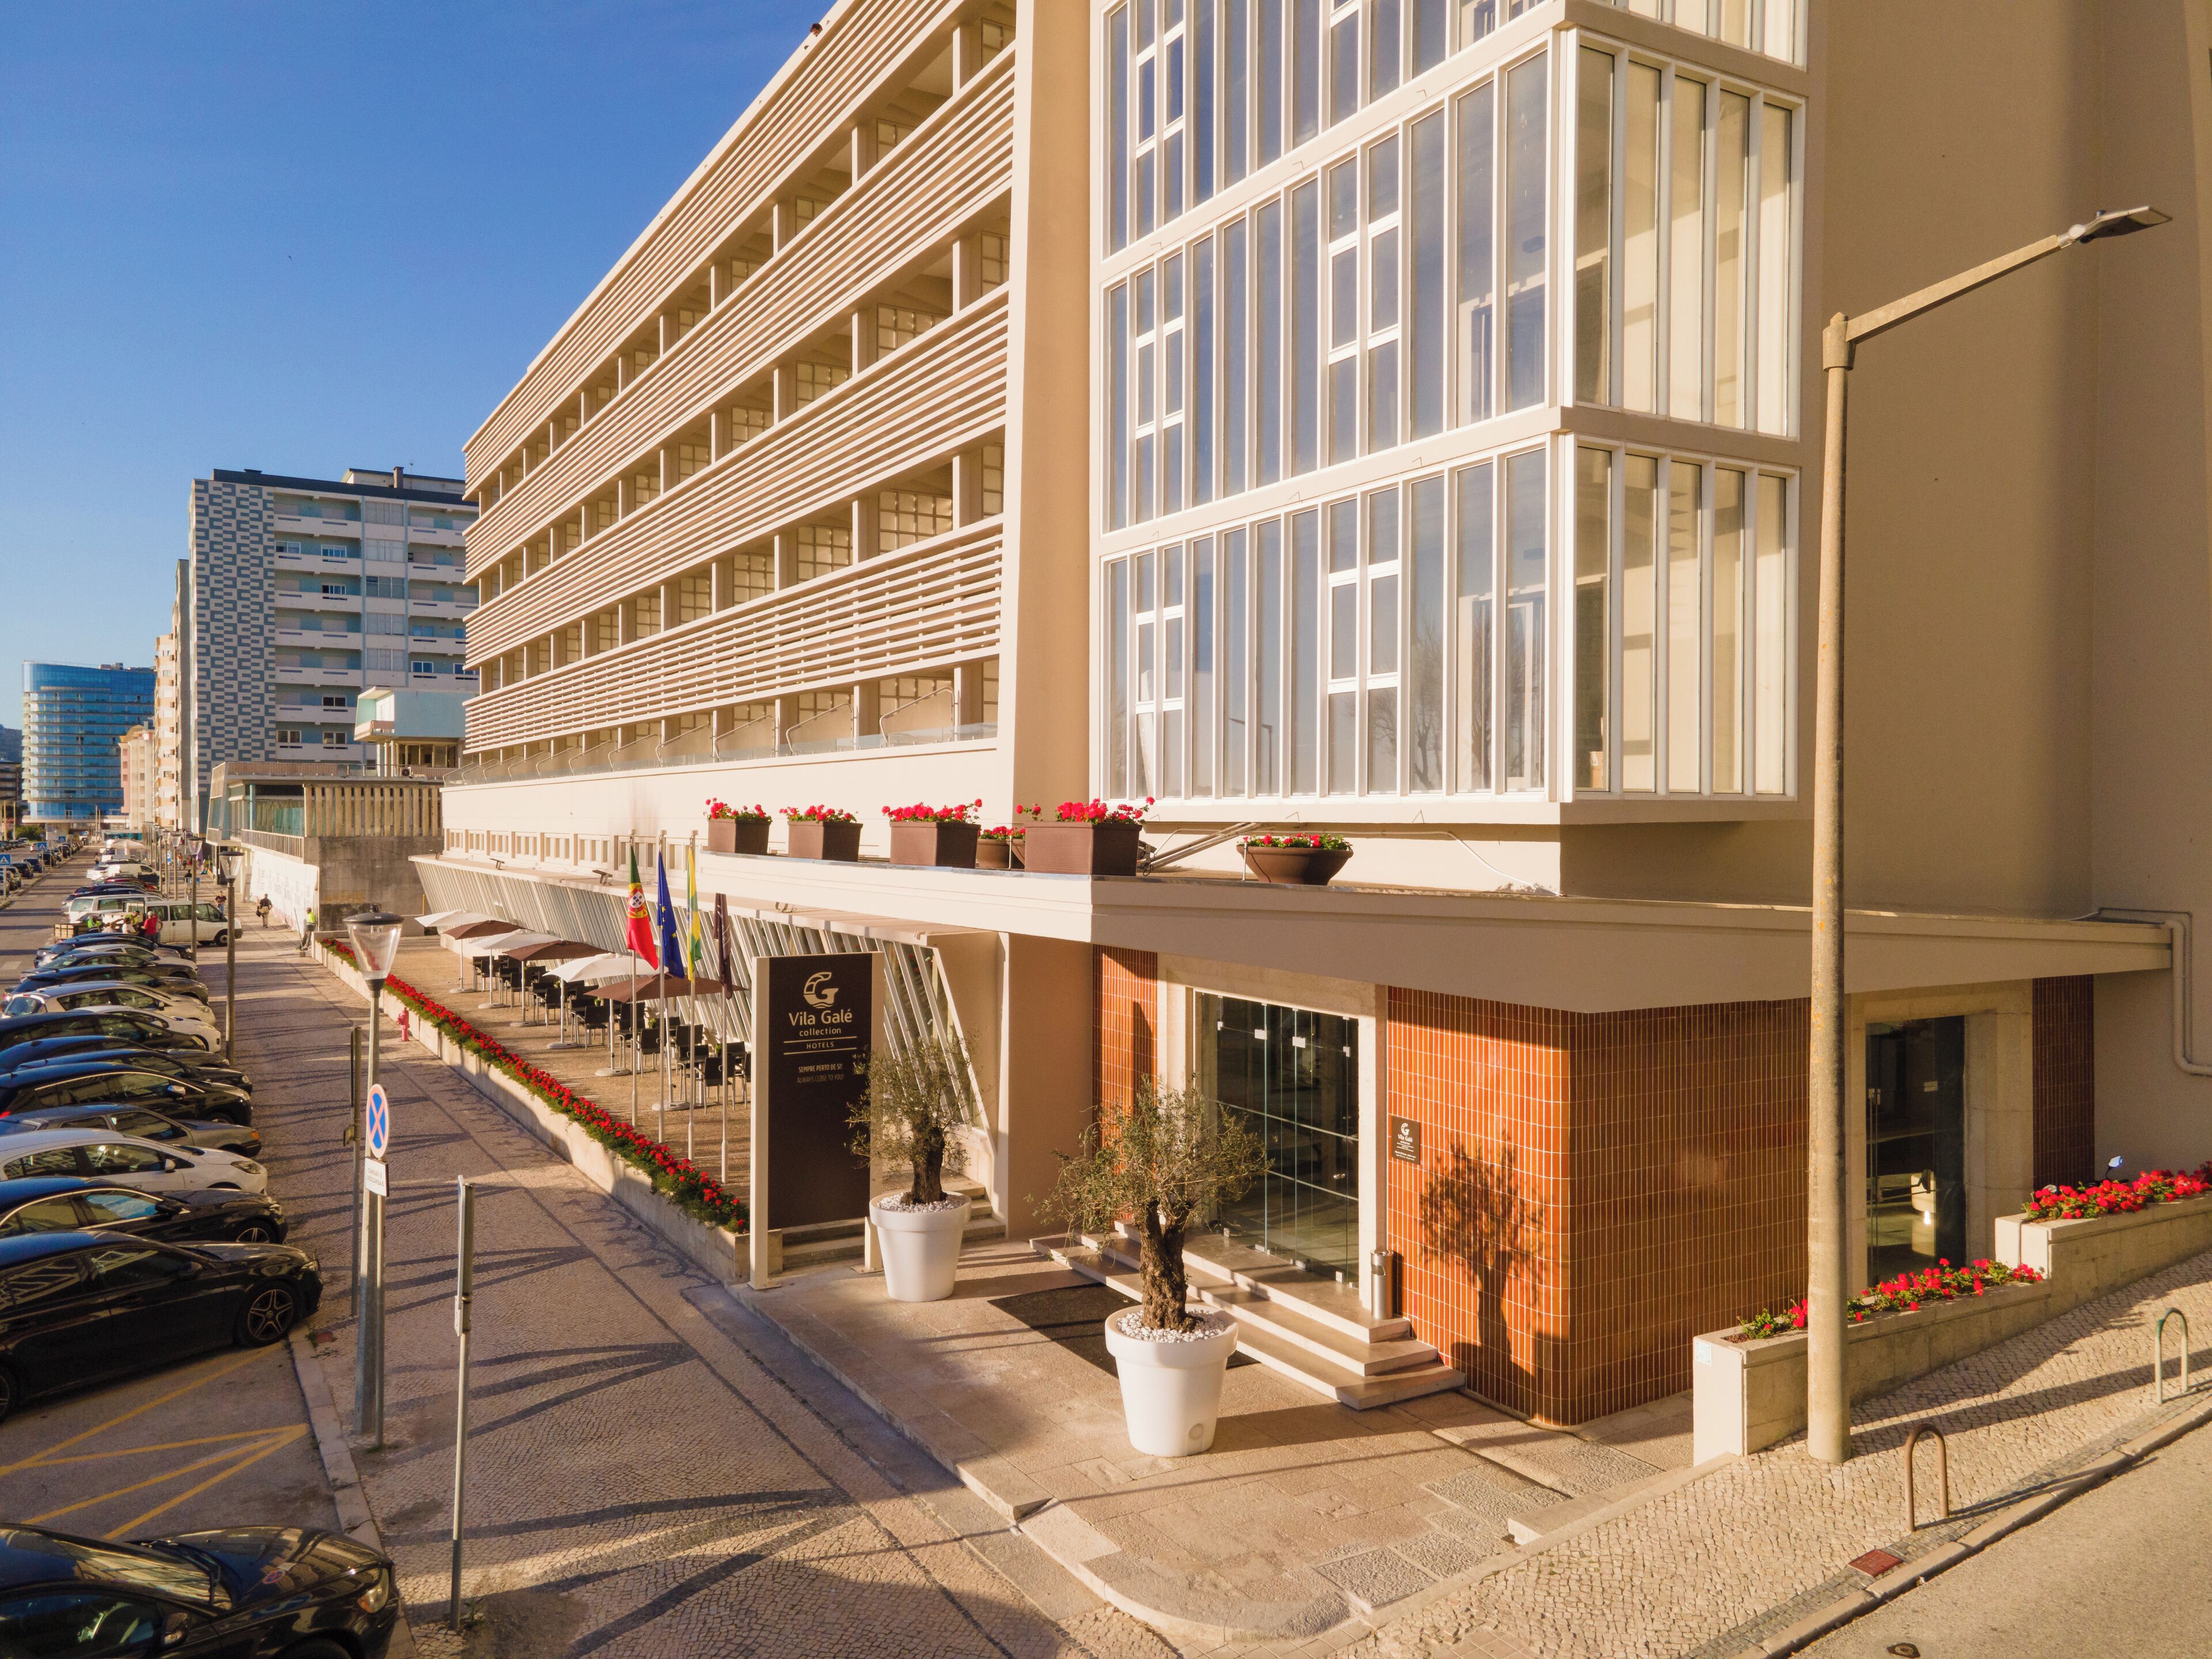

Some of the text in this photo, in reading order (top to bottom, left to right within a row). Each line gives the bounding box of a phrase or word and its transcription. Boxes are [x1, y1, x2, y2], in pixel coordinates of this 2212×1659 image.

[789, 1009, 853, 1026] Vila Galé
[799, 1027, 842, 1036] collection
[798, 1065, 815, 1073] SEMPRE
